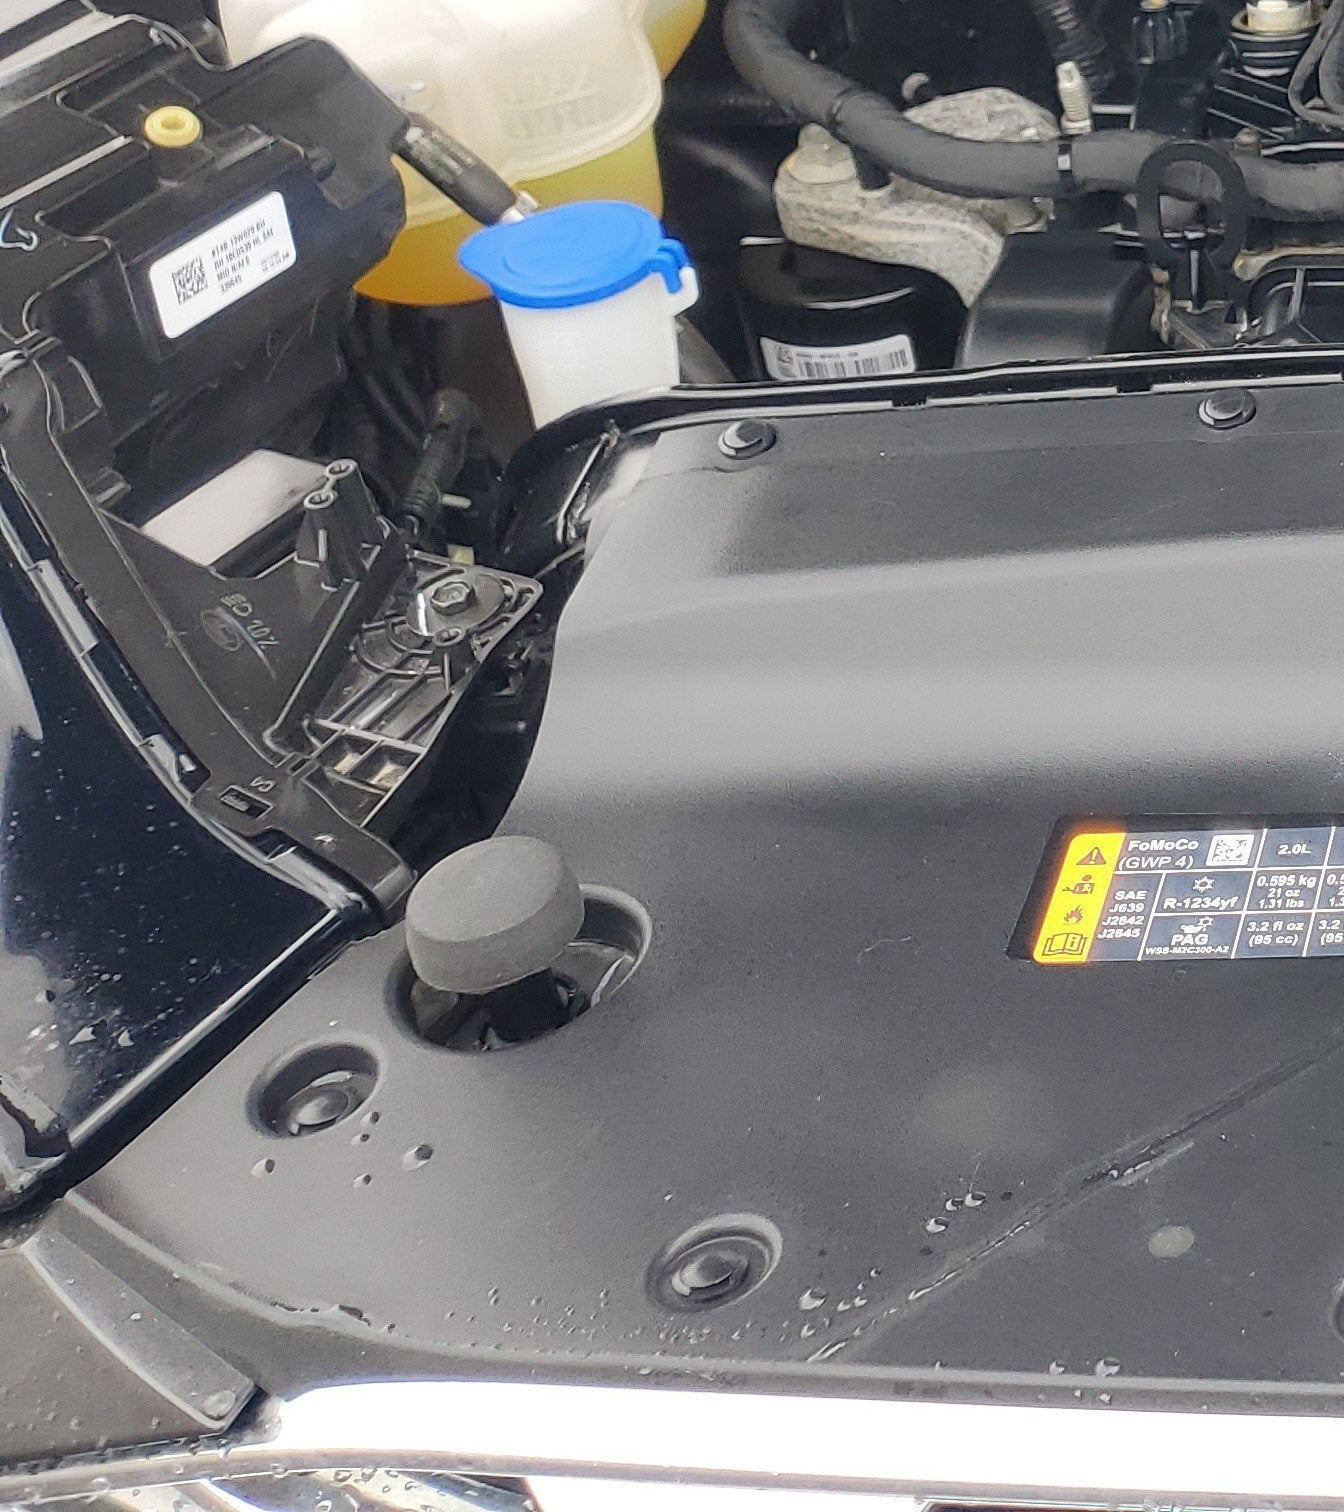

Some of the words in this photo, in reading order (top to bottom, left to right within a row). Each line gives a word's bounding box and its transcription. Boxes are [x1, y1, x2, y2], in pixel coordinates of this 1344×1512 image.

[1128, 839, 1199, 852] FoMoCo
[1278, 844, 1311, 854] 2.0L
[1119, 856, 1172, 871] (GWP
[1175, 856, 1194, 870] 4)
[1256, 875, 1296, 886] 0.595
[1298, 875, 1317, 888] kg
[1115, 890, 1148, 900] SAE
[1267, 888, 1282, 898] 21
[1108, 903, 1144, 912] J639
[1258, 899, 1282, 908] 1.31
[1286, 898, 1306, 908] lbs
[1247, 922, 1270, 932] 3.2
[1286, 922, 1304, 930] oz
[1318, 920, 1340, 930] 3.2
[1171, 934, 1208, 946] PAG
[1249, 934, 1272, 948] (95
[1276, 934, 1298, 946] cc)
[1320, 932, 1344, 946] (95
